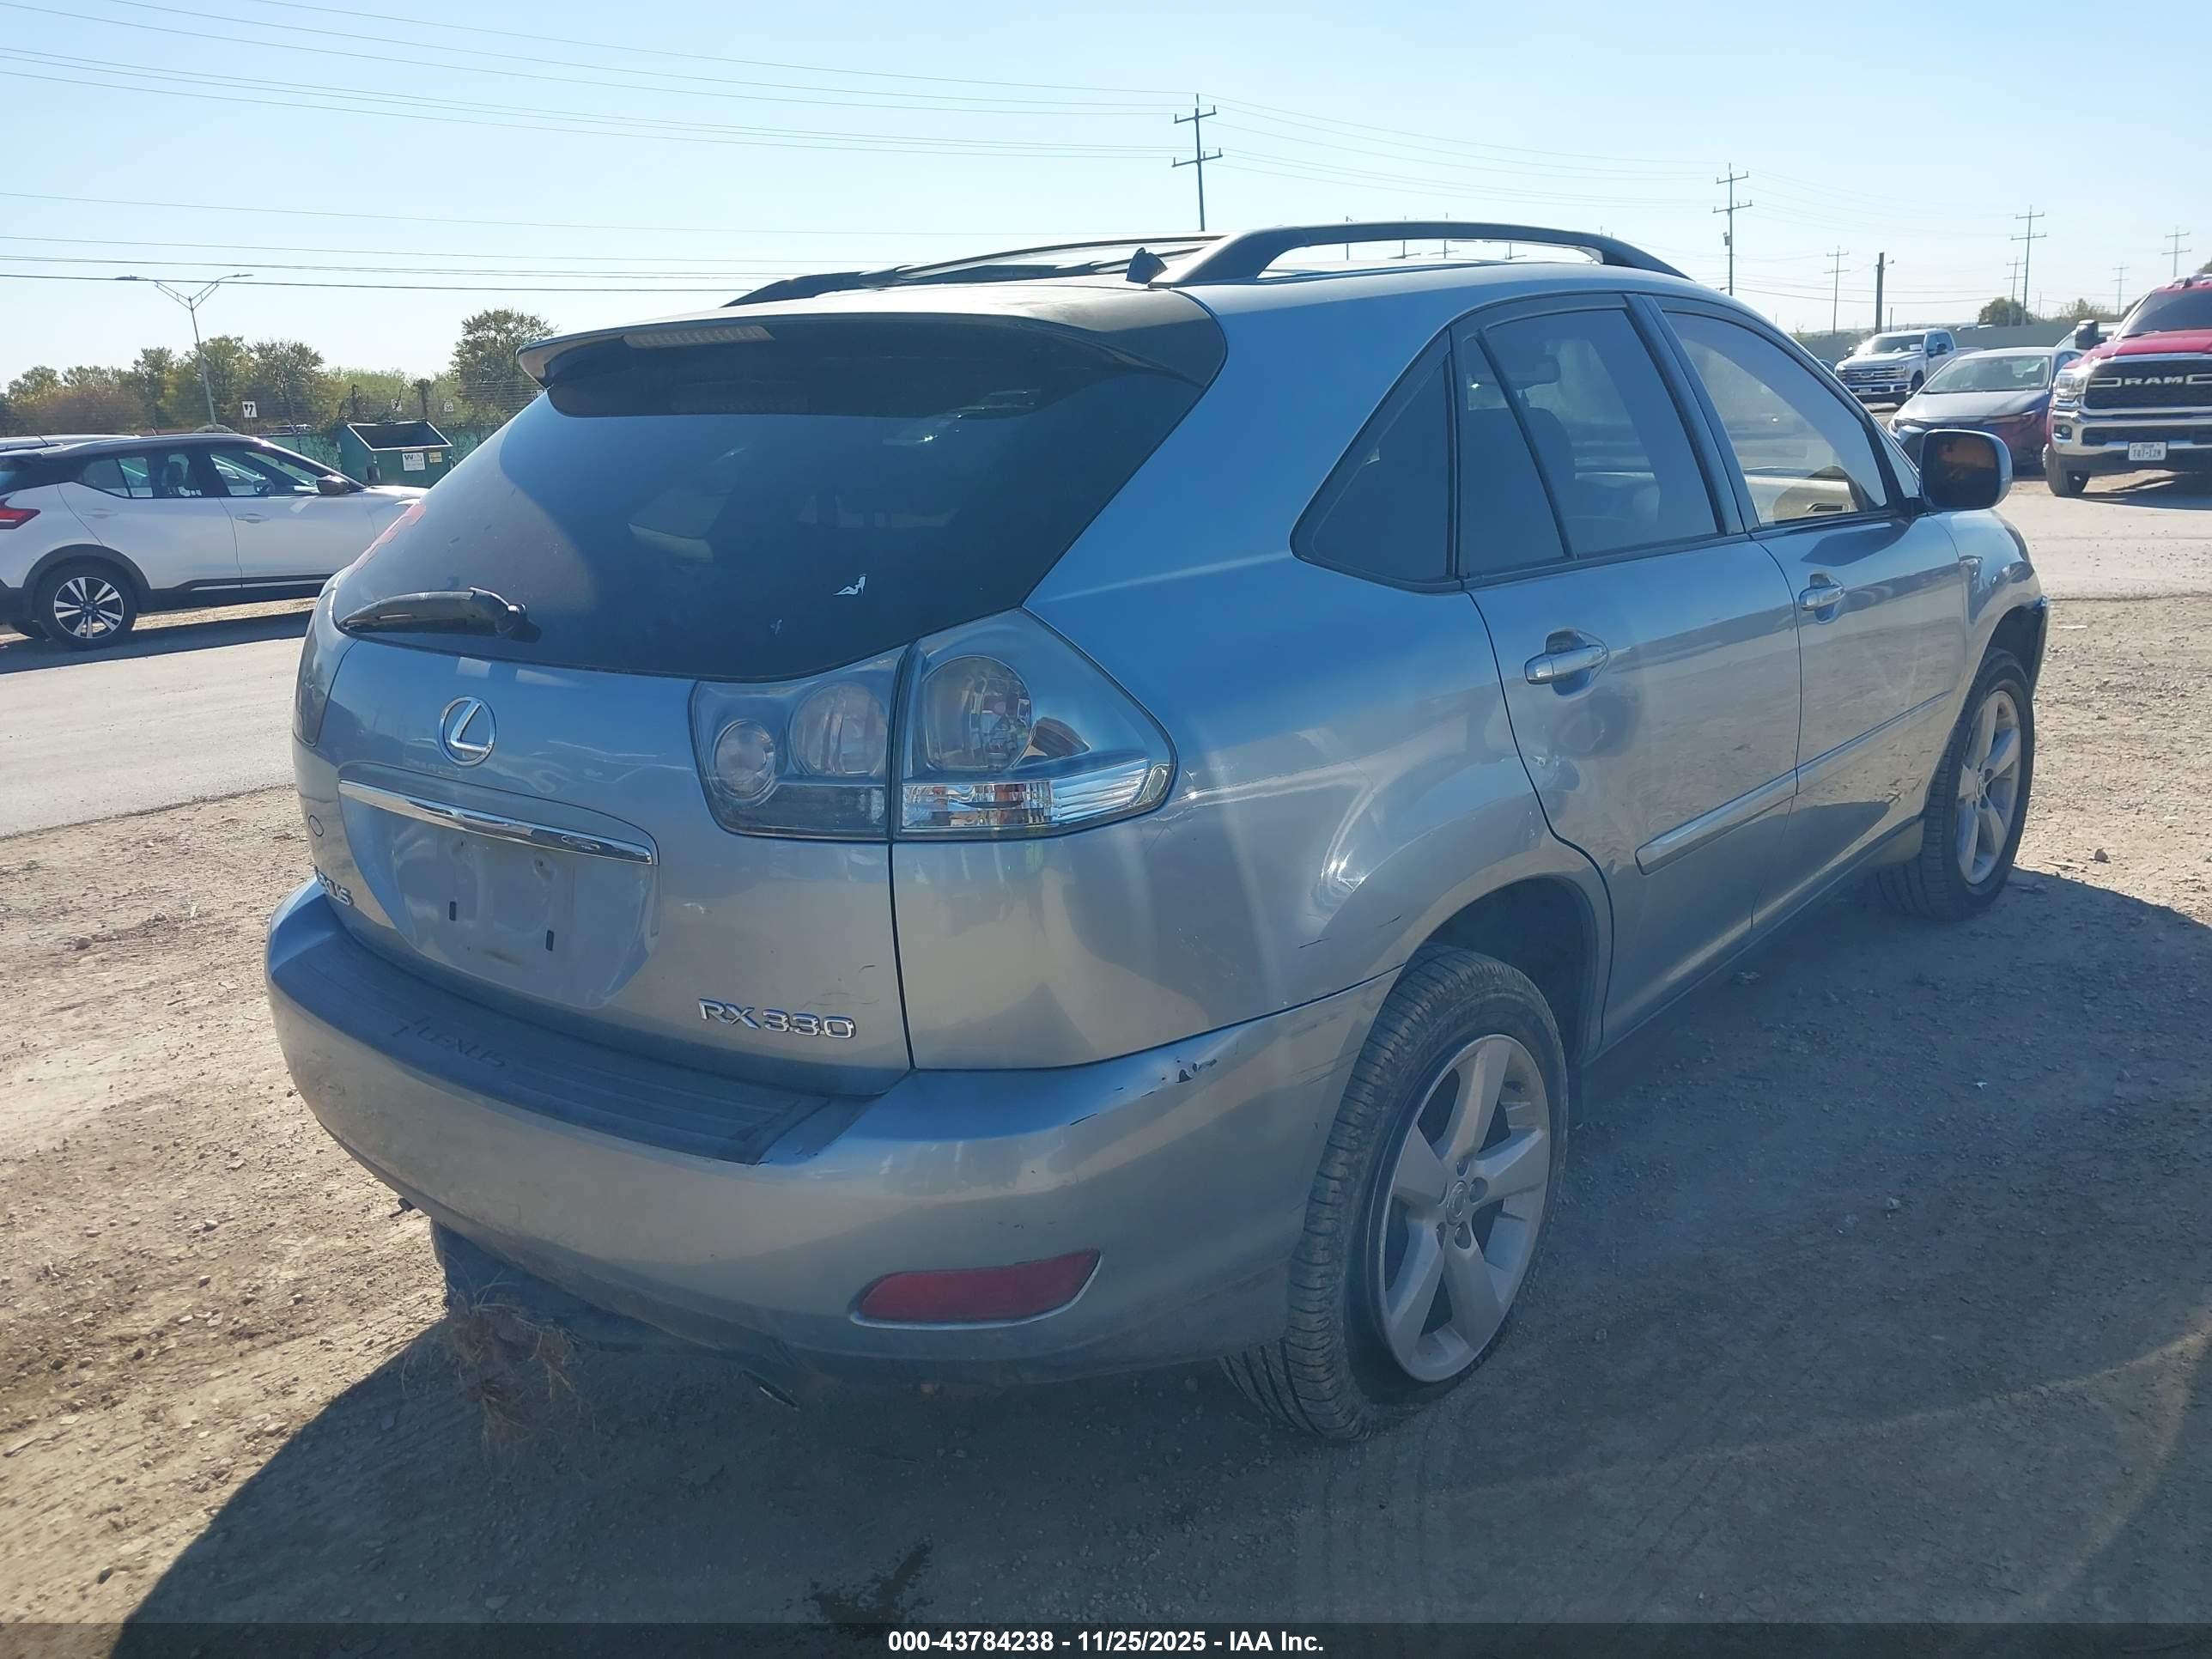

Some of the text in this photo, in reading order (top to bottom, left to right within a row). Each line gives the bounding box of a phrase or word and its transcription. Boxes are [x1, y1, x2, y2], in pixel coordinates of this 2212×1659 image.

[2124, 376, 2184, 385] RAM
[698, 998, 857, 1039] RX 330
